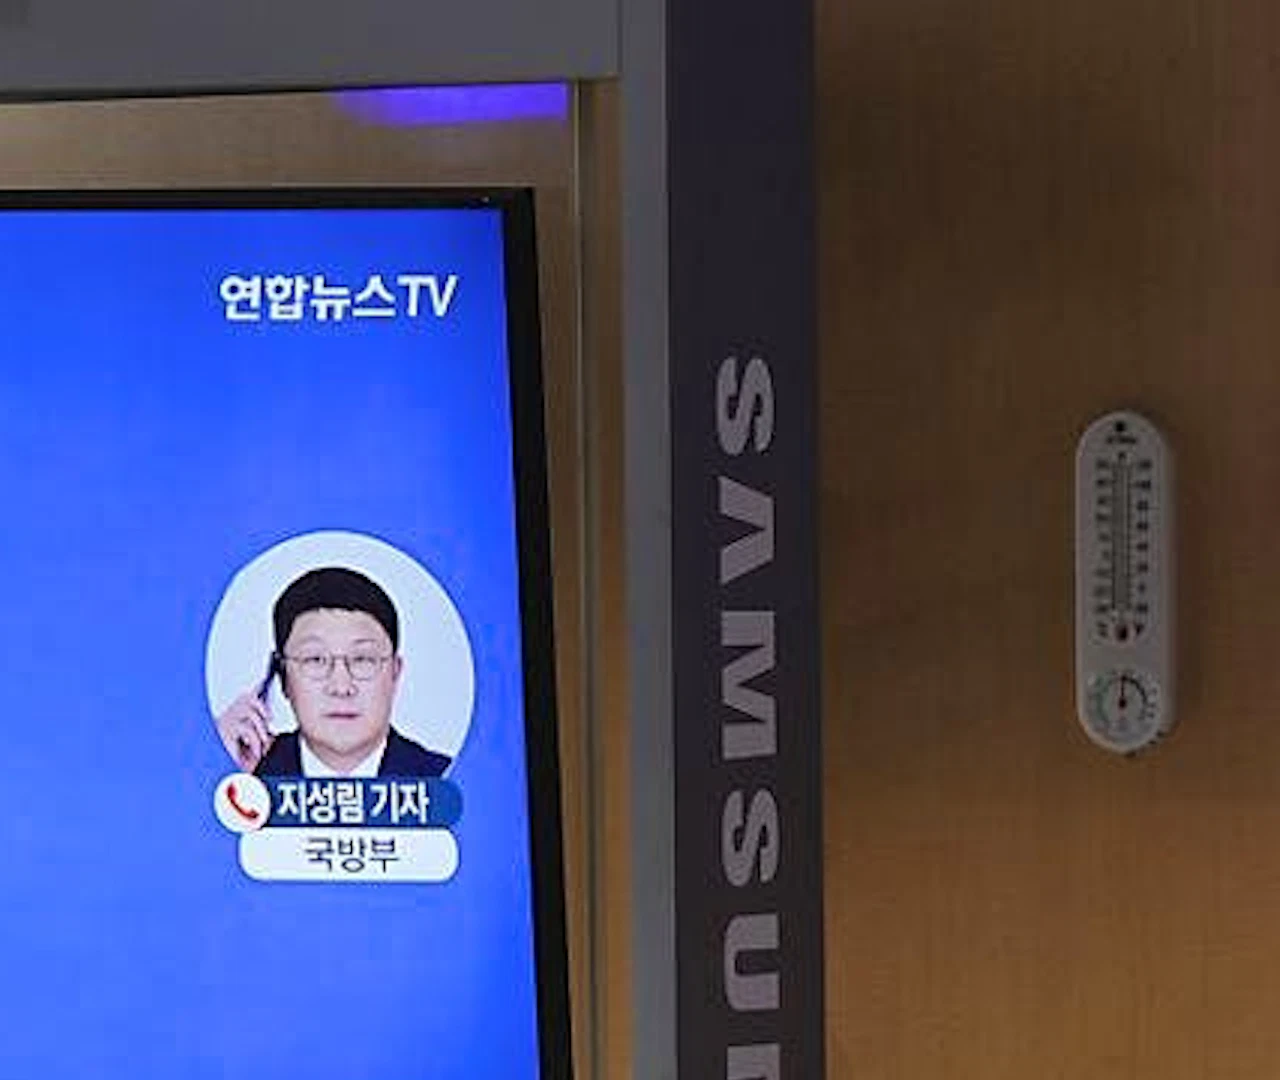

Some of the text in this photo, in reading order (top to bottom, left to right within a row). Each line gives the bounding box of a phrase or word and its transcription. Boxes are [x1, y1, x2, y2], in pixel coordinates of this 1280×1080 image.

[220, 273, 458, 321] 연합뉴스TV
[276, 780, 430, 825] 지성림 기자
[304, 837, 400, 873] 국방부
